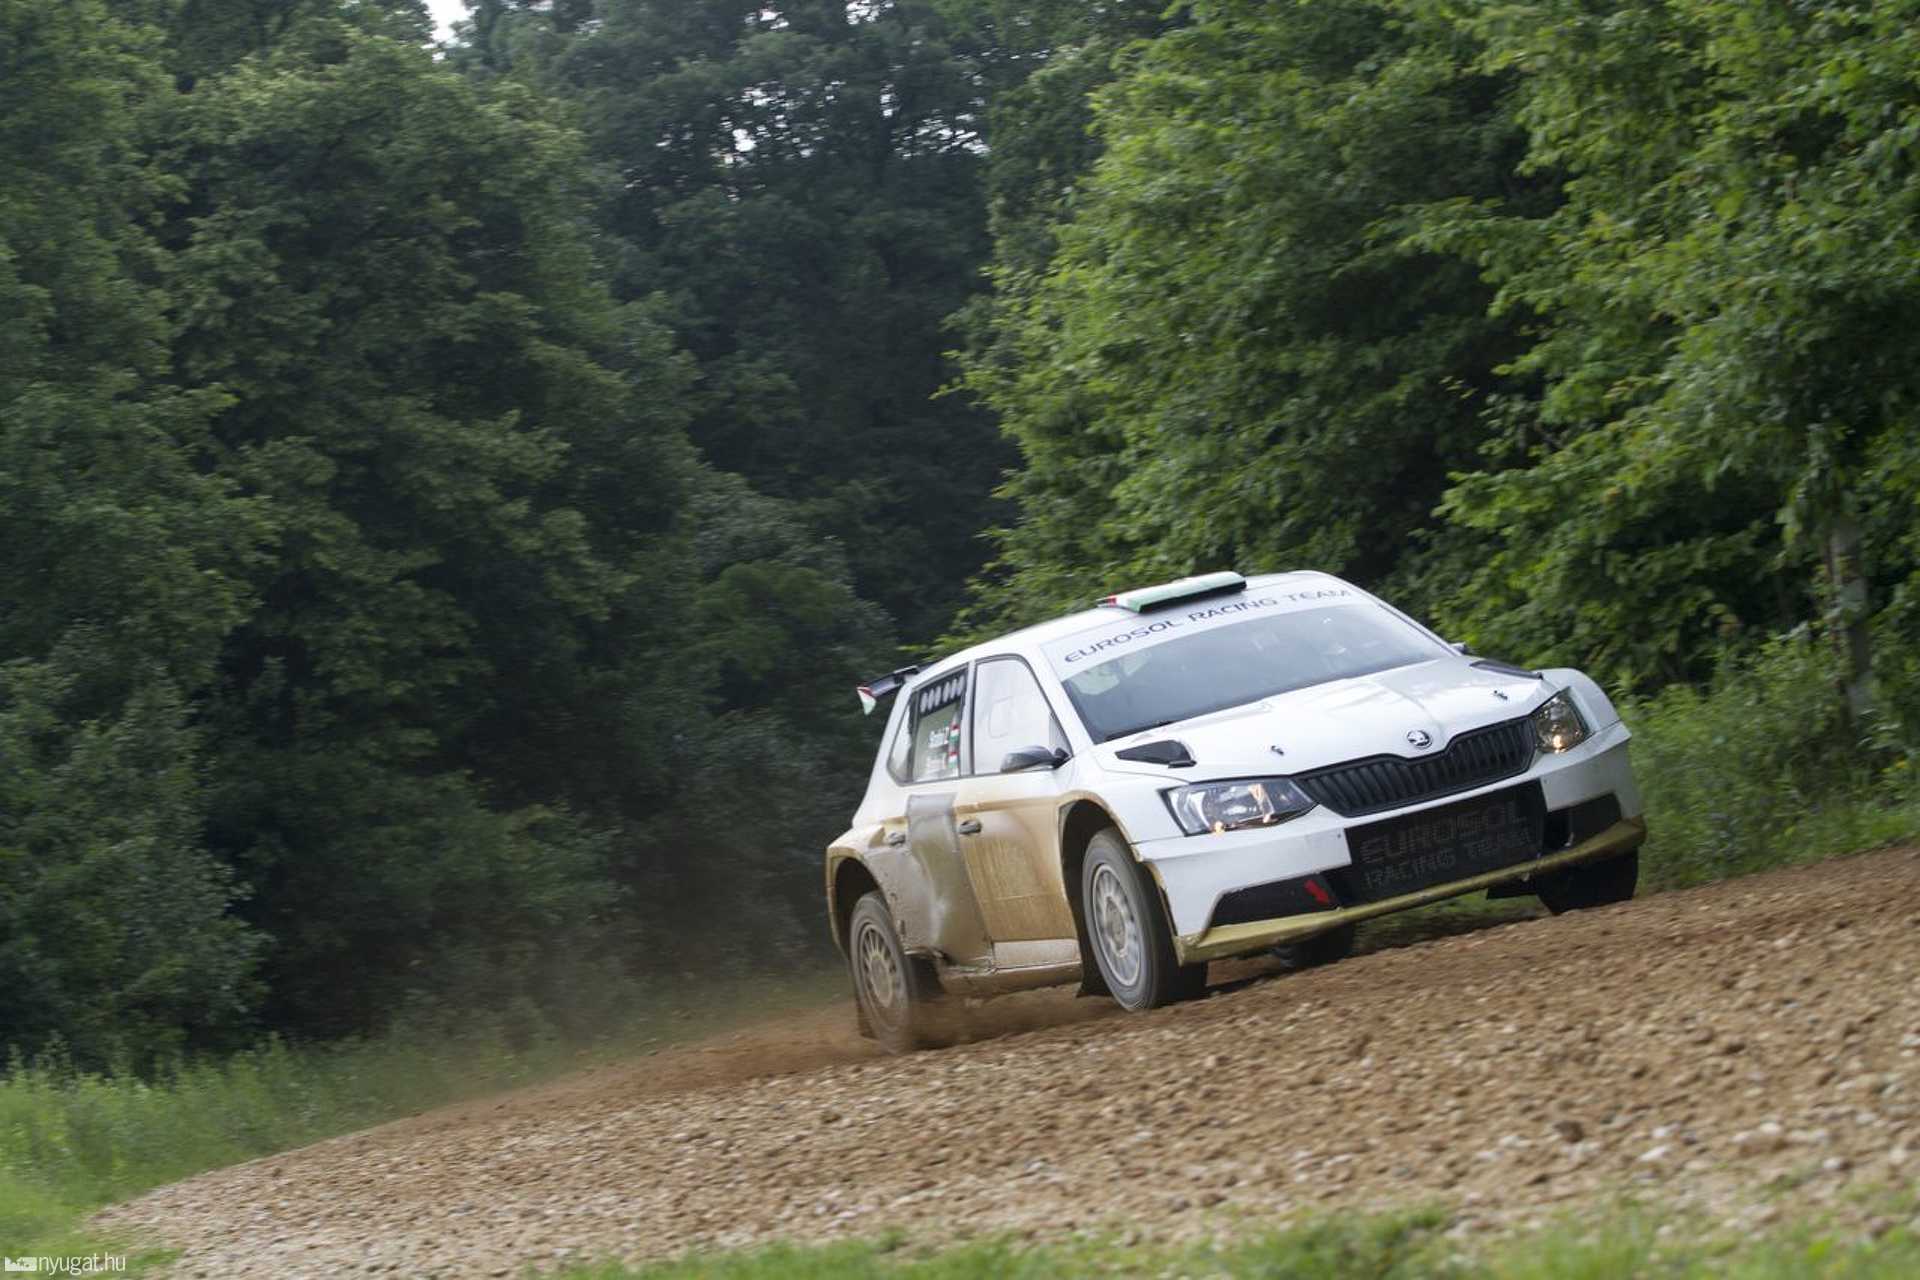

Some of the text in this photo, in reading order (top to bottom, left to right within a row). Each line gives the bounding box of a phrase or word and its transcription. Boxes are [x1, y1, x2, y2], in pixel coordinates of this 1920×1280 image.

[1063, 588, 1352, 664] EUROSOL RACING TEAM
[1359, 800, 1527, 865] EUROSOL
[1364, 847, 1457, 889] RACING
